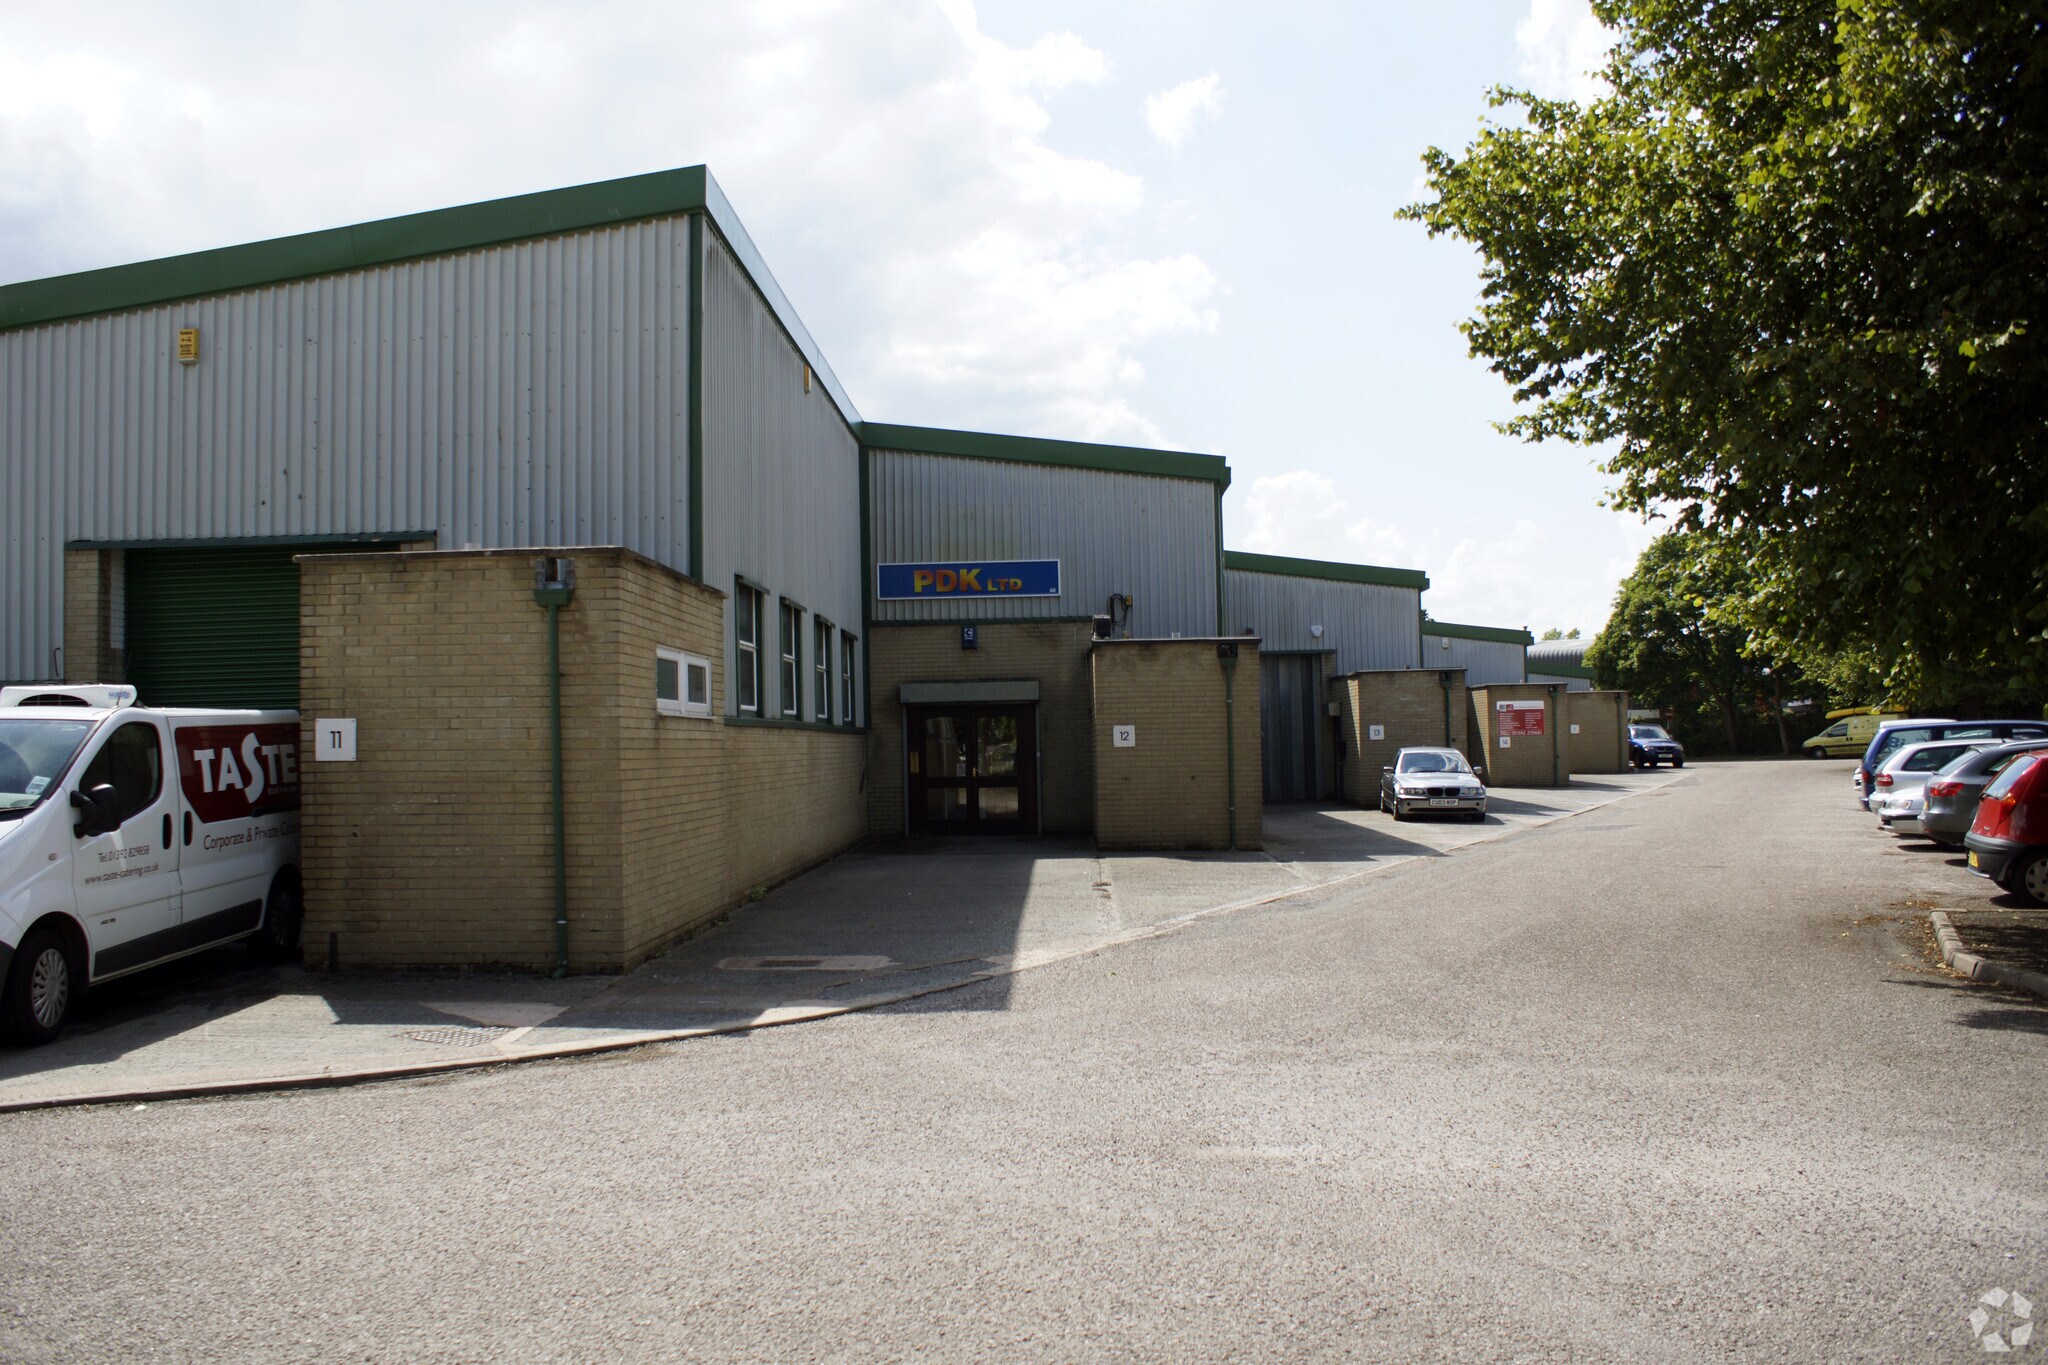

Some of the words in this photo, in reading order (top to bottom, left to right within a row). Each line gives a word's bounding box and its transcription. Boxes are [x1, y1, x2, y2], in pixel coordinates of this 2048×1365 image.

[914, 568, 983, 593] PDK
[987, 578, 1022, 591] LTD
[330, 731, 342, 749] 11
[1119, 731, 1130, 741] 12
[193, 732, 299, 804] TASTE
[203, 833, 245, 852] Corporate
[246, 828, 253, 842] &
[254, 825, 280, 842] Private
[84, 863, 160, 885] www.taste-catering.co.uk
